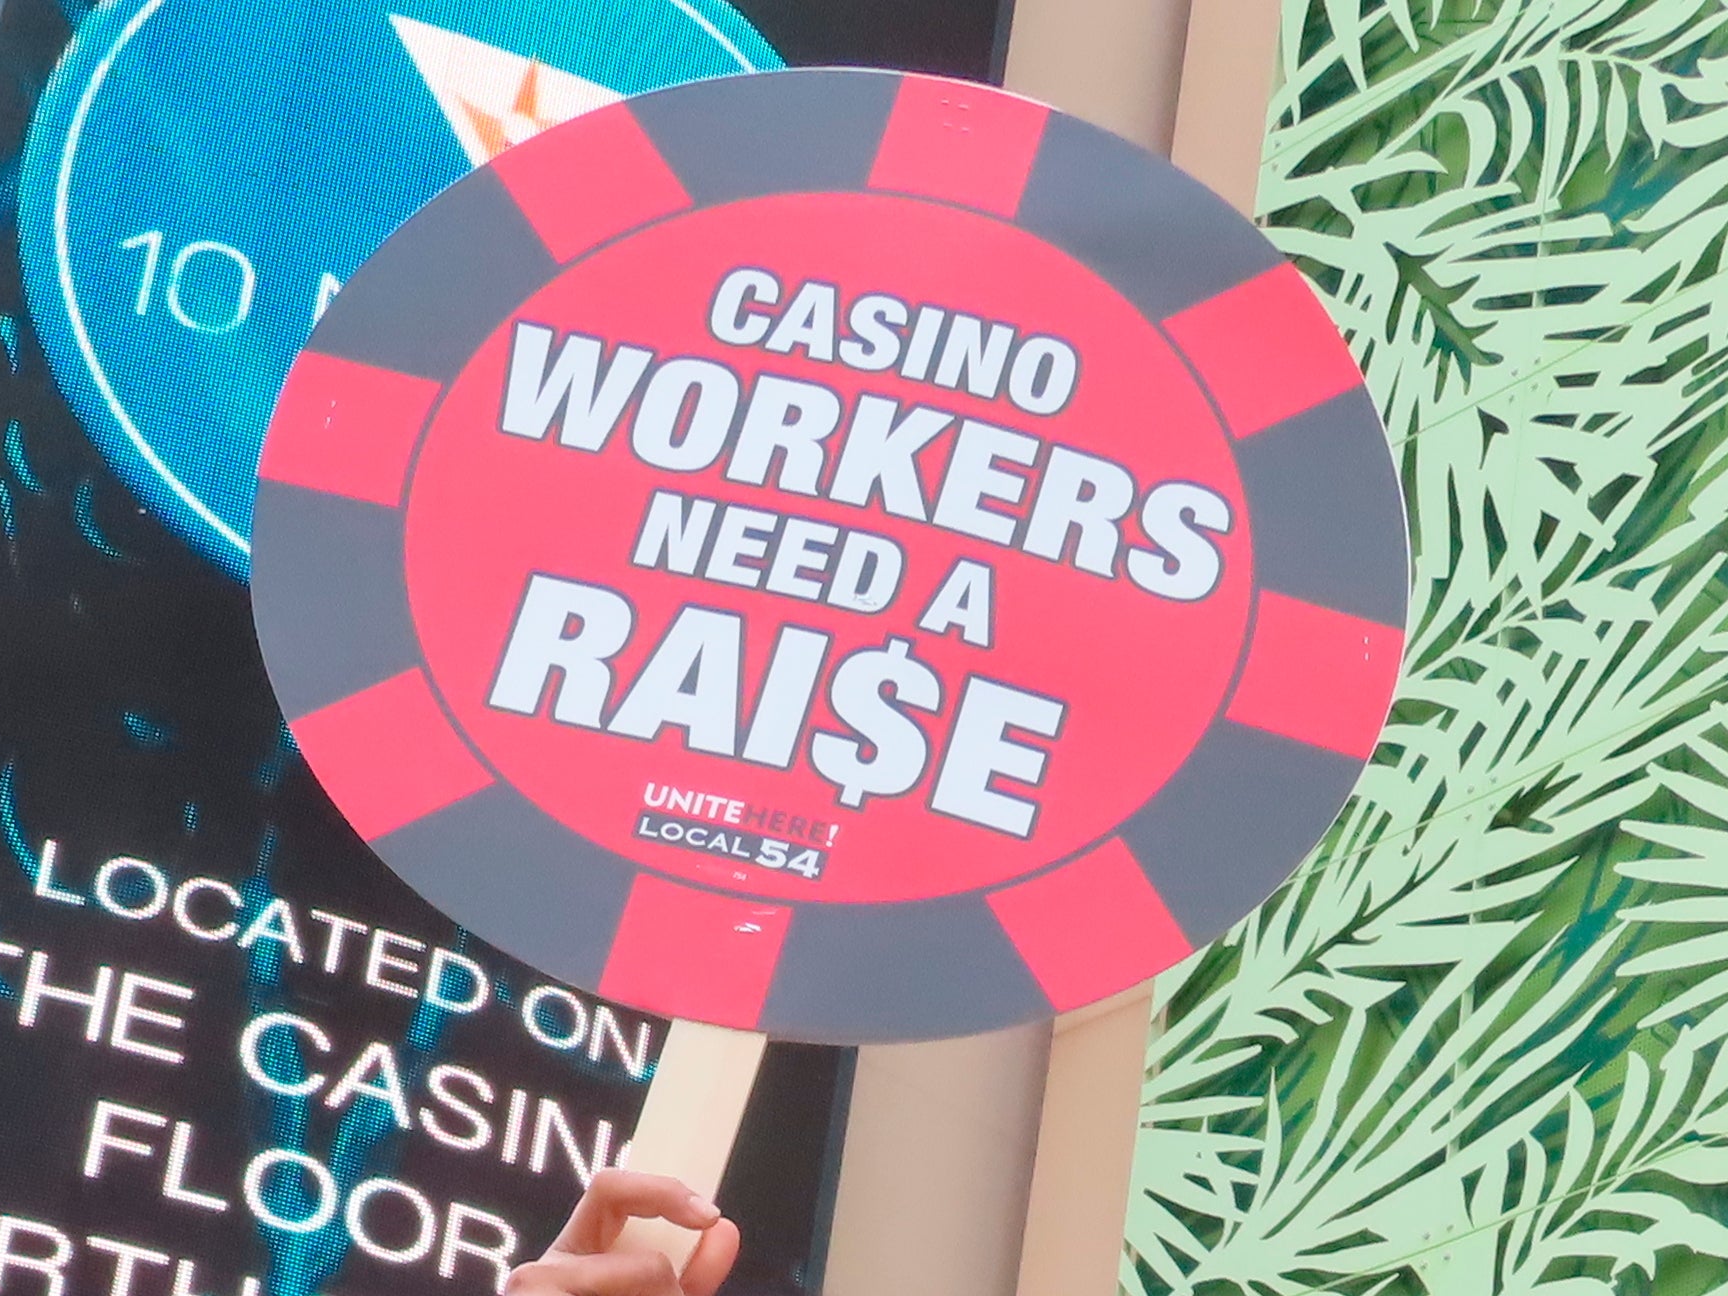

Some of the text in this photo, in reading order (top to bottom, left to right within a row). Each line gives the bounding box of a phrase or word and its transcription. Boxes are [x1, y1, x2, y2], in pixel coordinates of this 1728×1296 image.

[121, 230, 256, 334] 10
[708, 266, 1076, 417] CASINO
[498, 321, 1232, 602] WORKERS
[632, 489, 995, 648] NEED A
[489, 573, 1065, 837] RAI$E
[638, 816, 820, 878] LOCAL 54
[34, 838, 652, 1081] LOCATED ON
[238, 1014, 632, 1190] CASIN
[83, 1100, 519, 1296] FLOOR
